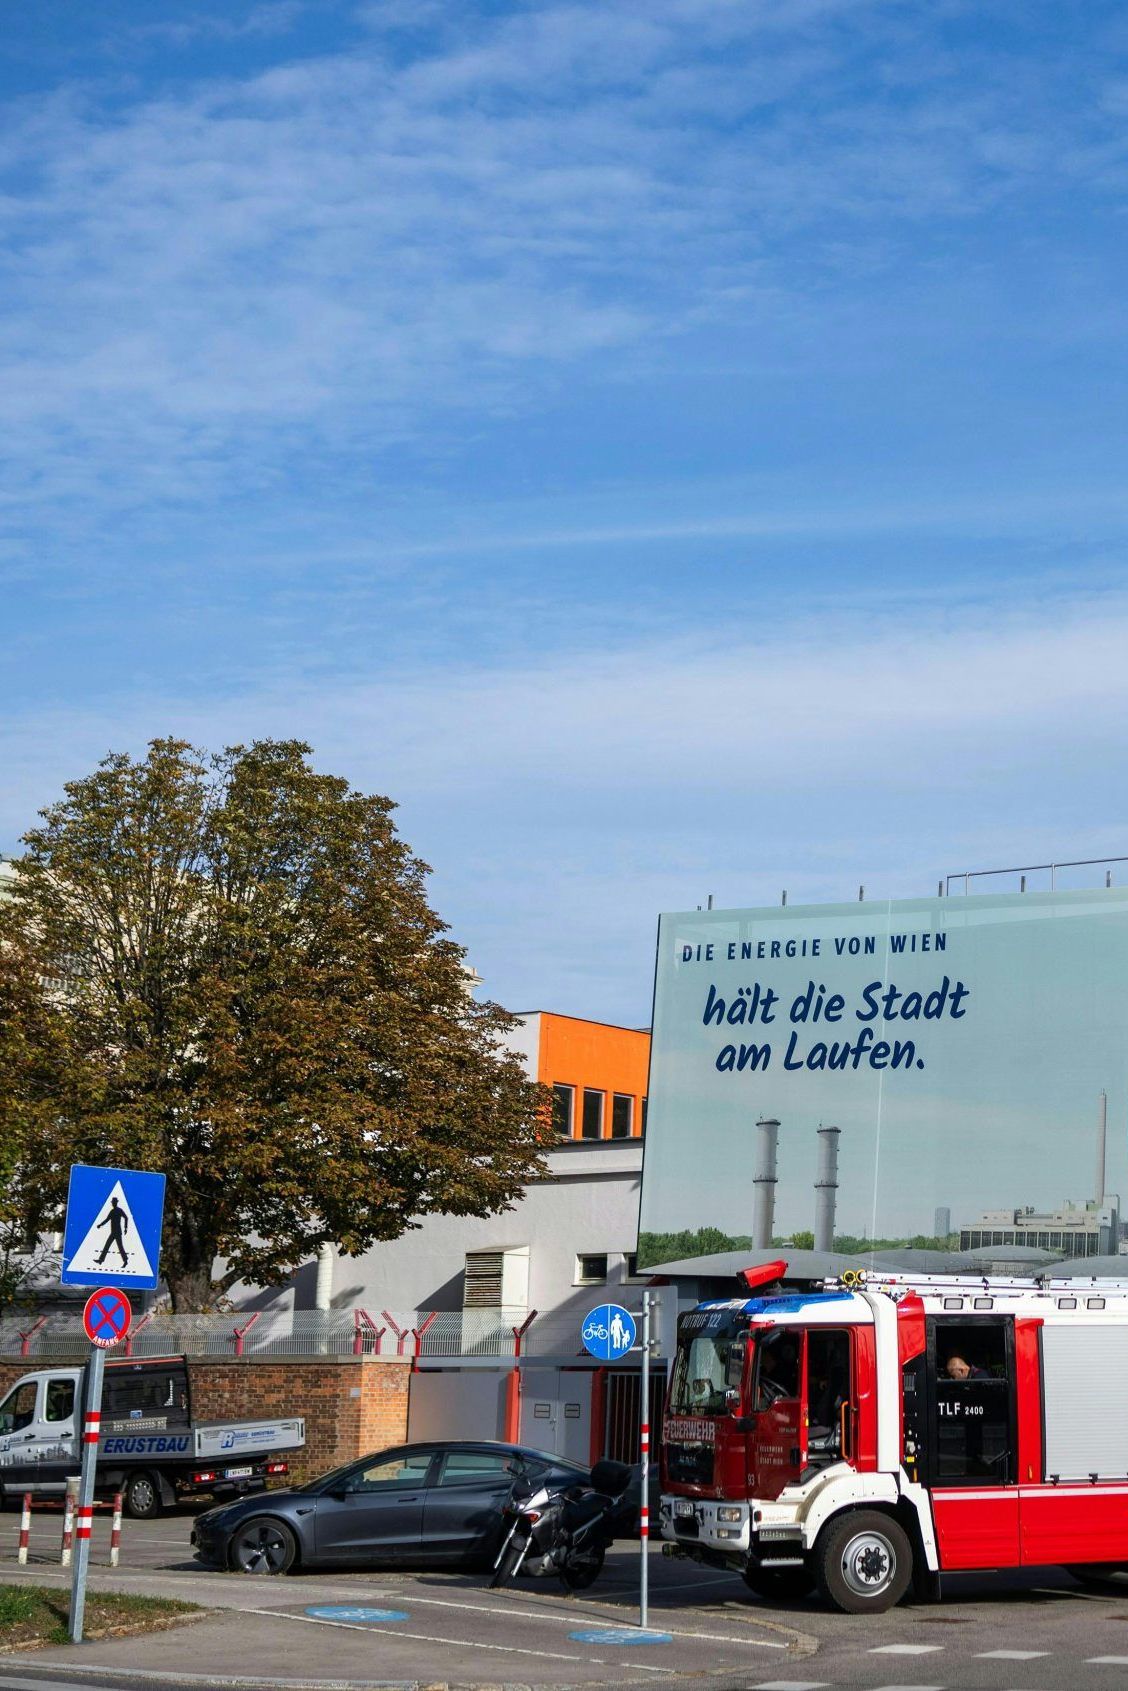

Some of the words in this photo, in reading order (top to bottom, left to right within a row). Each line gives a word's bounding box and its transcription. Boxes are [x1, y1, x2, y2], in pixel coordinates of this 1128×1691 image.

[682, 944, 715, 962] DIE
[727, 938, 822, 960] ENERGIE
[834, 936, 876, 955] VON
[890, 932, 947, 953] WIEN
[703, 982, 779, 1026] hält
[789, 980, 845, 1023] die
[855, 976, 970, 1021] Stadt
[715, 1042, 771, 1072] am
[784, 1027, 925, 1072] Laufen.
[707, 1313, 722, 1328] 122
[93, 1335, 119, 1347] ANFANG
[938, 1402, 961, 1416] TLF
[965, 1406, 984, 1416] 2400
[664, 1419, 715, 1441] FEUERWEHR
[103, 1435, 190, 1454] ERÜSTBAU
